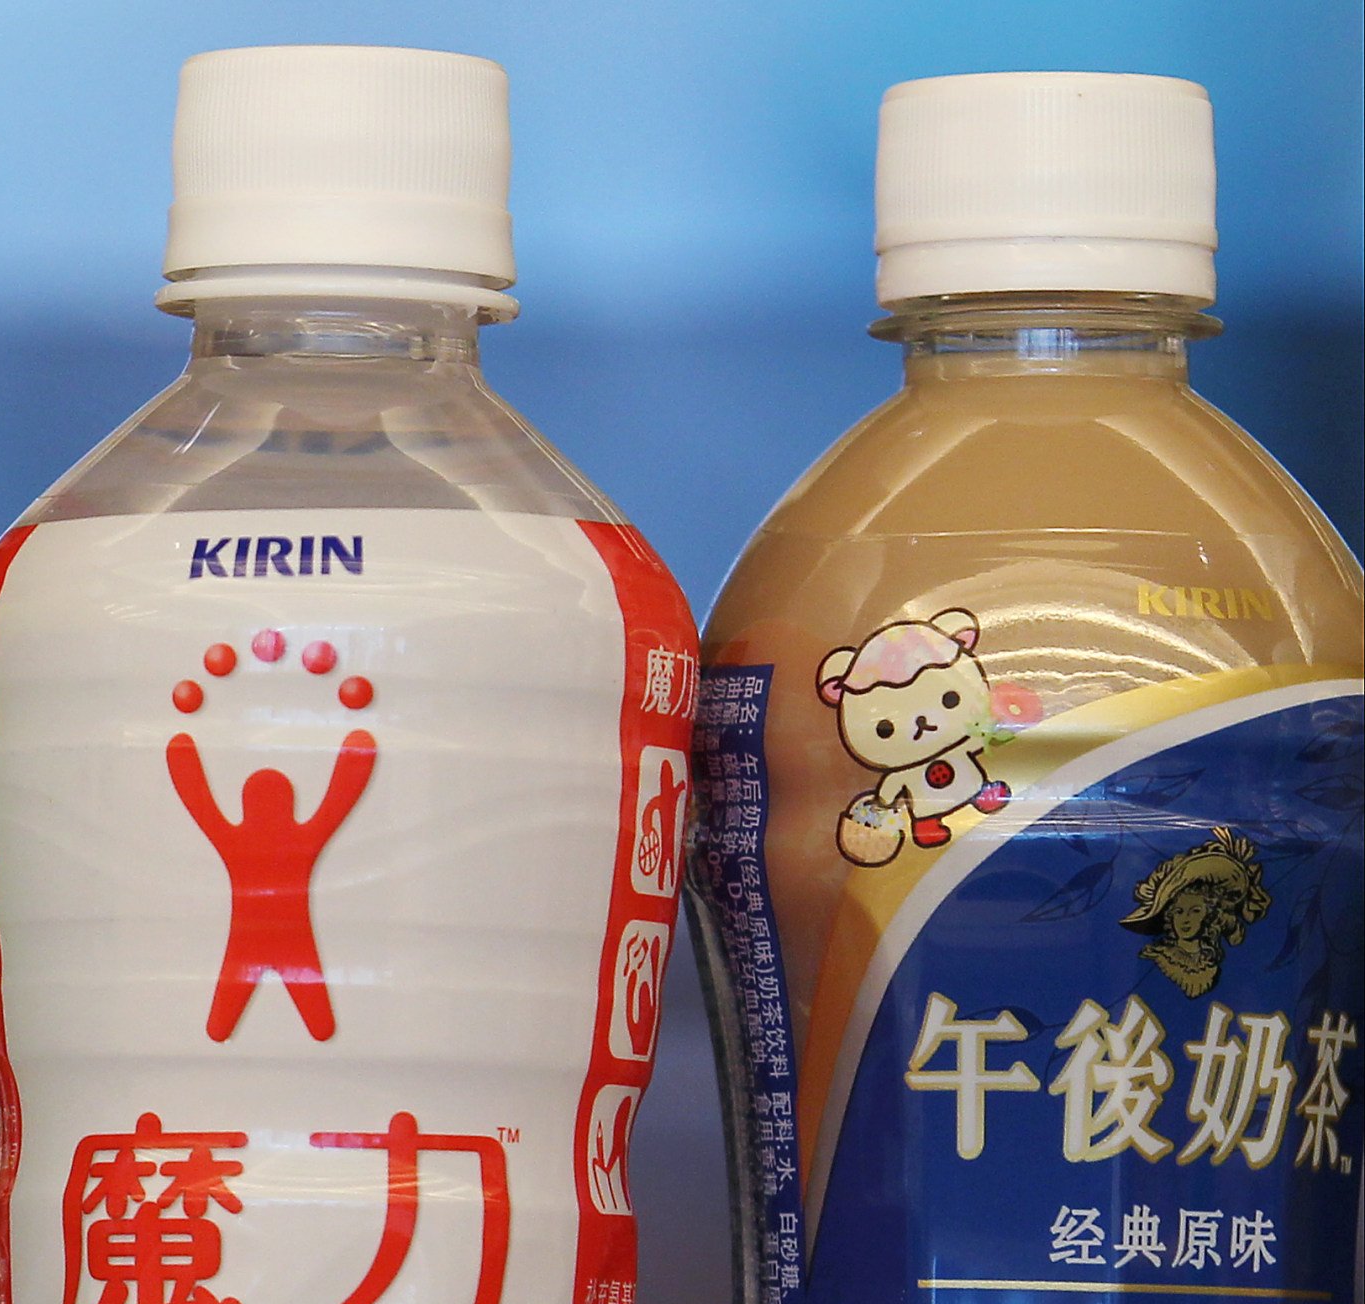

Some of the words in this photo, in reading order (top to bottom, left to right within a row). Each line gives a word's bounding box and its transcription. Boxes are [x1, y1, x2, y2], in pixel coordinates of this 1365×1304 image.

[188, 535, 364, 579] KIRIN
[1138, 584, 1276, 622] KIRIN
[640, 644, 701, 721] 魔力
[904, 991, 1357, 1170] 午後奶茶
[496, 1127, 521, 1143] TM
[1049, 1203, 1277, 1274] 经典原味
